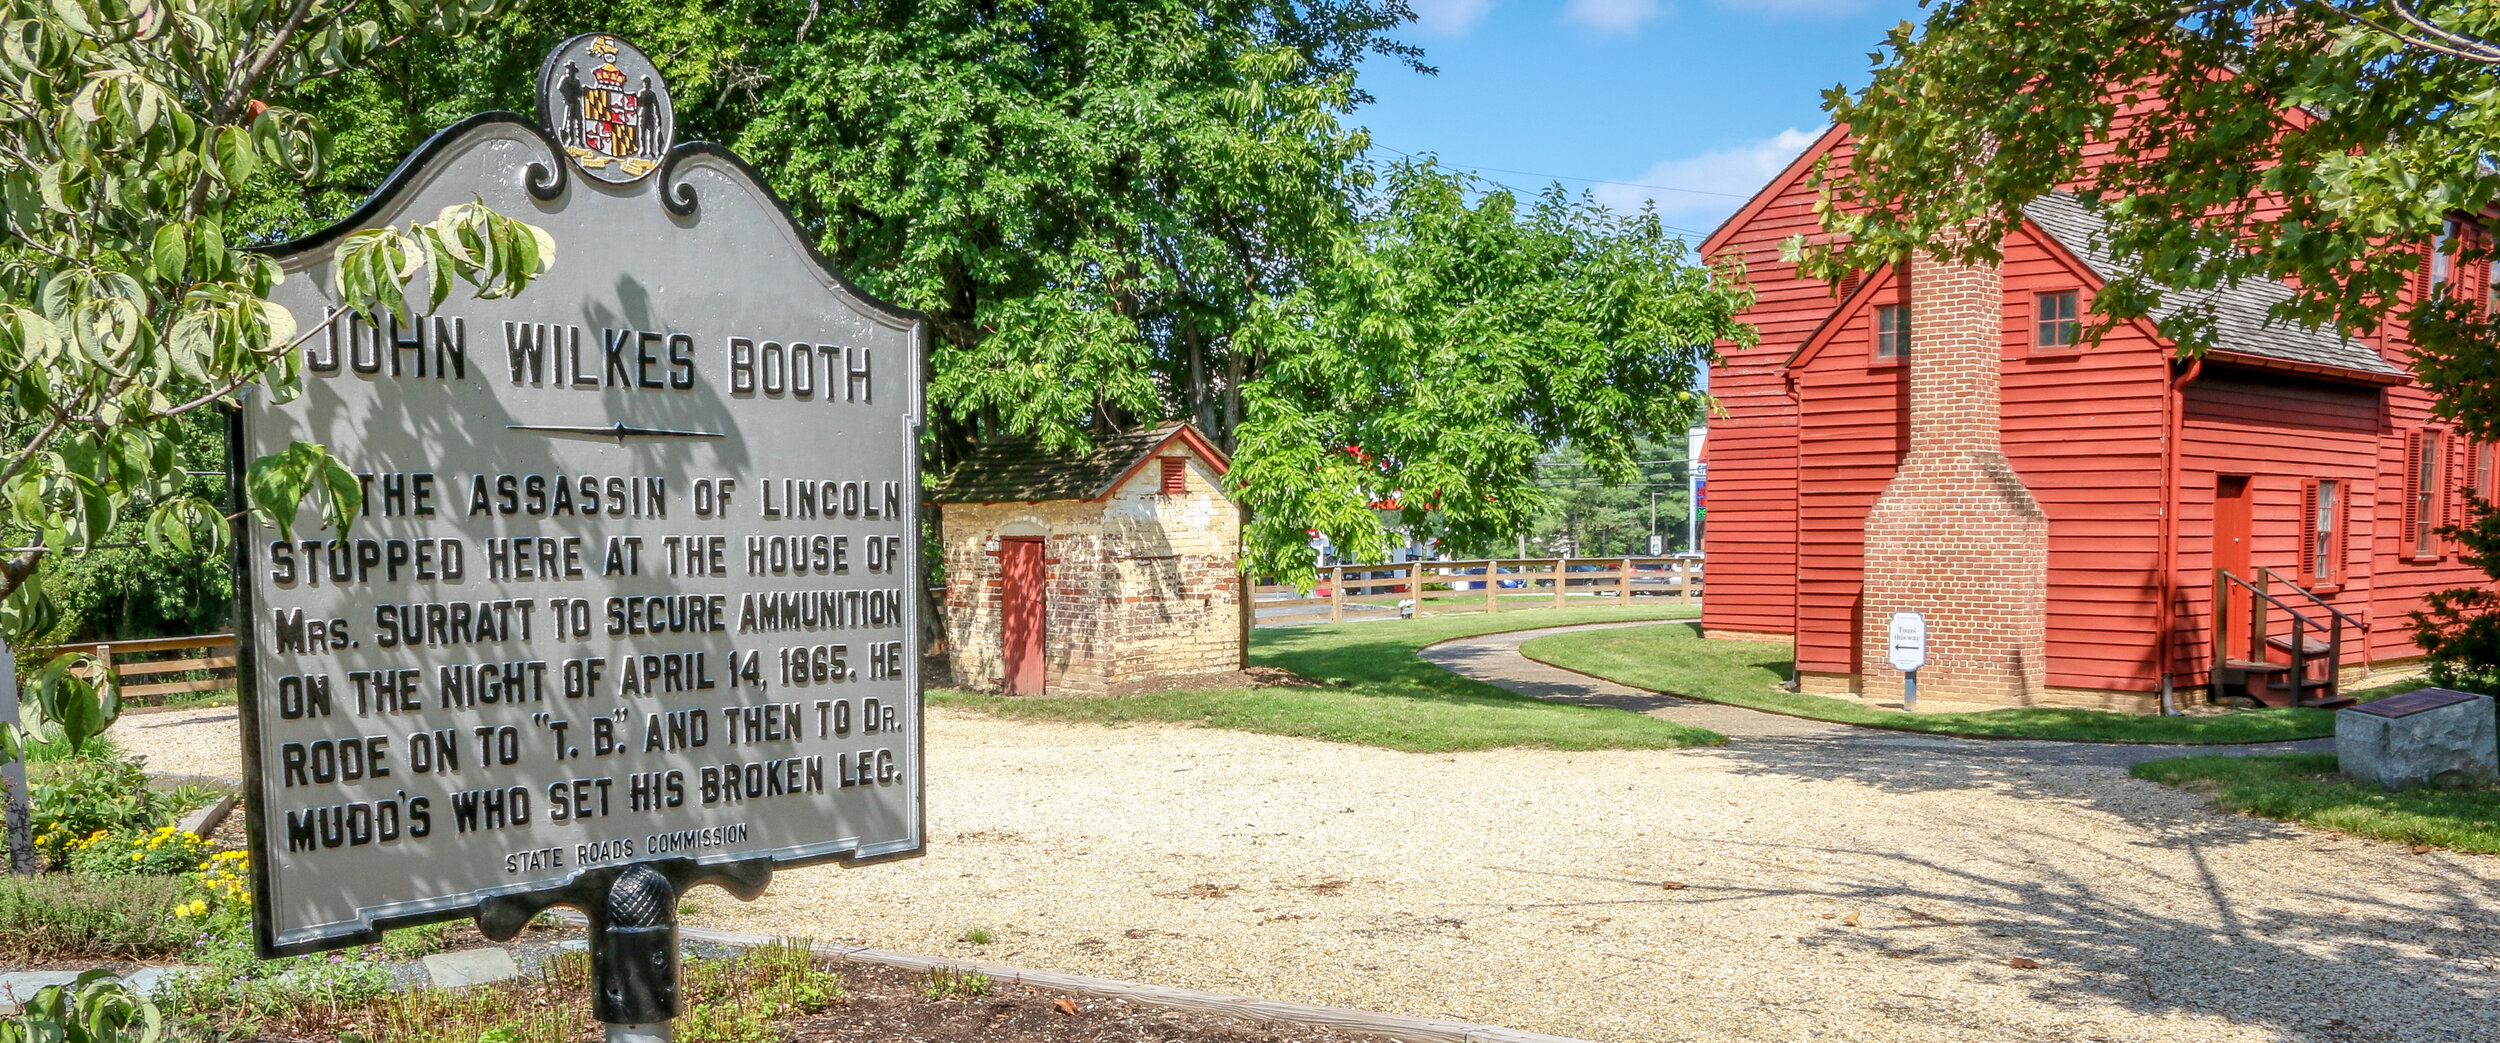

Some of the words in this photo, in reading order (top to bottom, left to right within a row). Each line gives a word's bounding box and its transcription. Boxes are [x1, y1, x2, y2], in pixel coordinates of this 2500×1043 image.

[304, 306, 465, 379] JOHN
[504, 321, 696, 390] WILKES
[728, 336, 873, 402] BOOTH
[356, 472, 435, 517] THE
[467, 474, 667, 517] ASSASSIN
[692, 478, 736, 515] OF
[760, 479, 900, 520] LINCOLN
[270, 538, 464, 584] STOPPED
[486, 538, 582, 580] HERE
[604, 537, 645, 576] AT
[662, 535, 727, 576] THE
[746, 535, 849, 574] HOUSE
[866, 537, 900, 572] OF
[376, 598, 533, 648] SURRATT
[549, 597, 591, 639] TO
[605, 595, 725, 637] SECURE
[738, 590, 901, 632] AMMUNITION
[278, 674, 329, 719] ON
[349, 670, 420, 716] THE
[440, 662, 547, 708] NIGHT
[563, 658, 605, 698] OF
[620, 652, 715, 696] APRIL
[728, 650, 768, 693] 14,
[779, 645, 856, 686] 1865.
[868, 641, 902, 679] HE
[281, 735, 390, 787] RODE
[410, 729, 459, 772] ON
[474, 725, 520, 767] TO
[643, 707, 708, 753] AND
[724, 703, 802, 746] THEN
[815, 697, 851, 738] TO
[285, 791, 430, 853] MUDD'S
[451, 785, 532, 834] WHO
[548, 776, 611, 822] SET
[630, 771, 684, 812] HIS
[699, 755, 824, 804] BROKEN
[838, 749, 902, 788] LEG.
[506, 848, 565, 873] STATE
[577, 839, 634, 867] ROADS
[647, 823, 749, 855] COMMISSION
